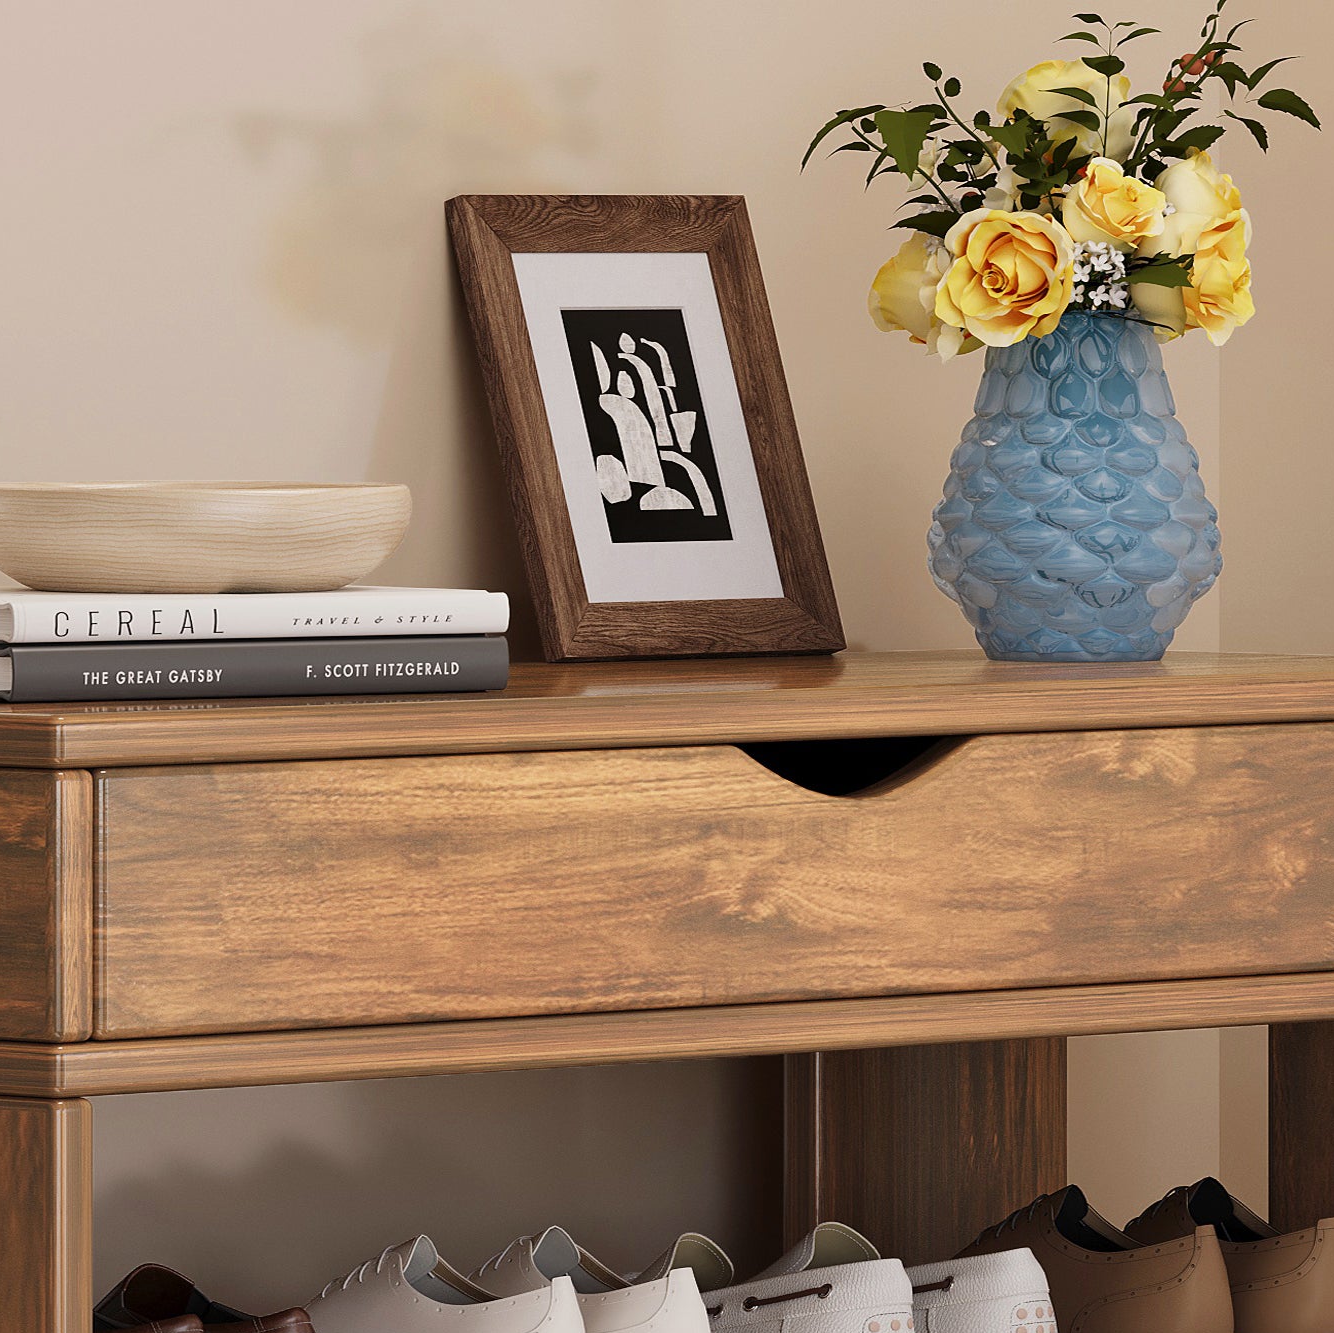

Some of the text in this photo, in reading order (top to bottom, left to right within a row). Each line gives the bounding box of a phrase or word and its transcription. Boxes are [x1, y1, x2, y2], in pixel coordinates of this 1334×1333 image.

[54, 608, 224, 638] CEREAL
[292, 614, 454, 626] TRAVEL & STYLE
[83, 669, 223, 685] THE GREAT GATSBY
[306, 661, 460, 678] F. SCOTT FITZGERALD
